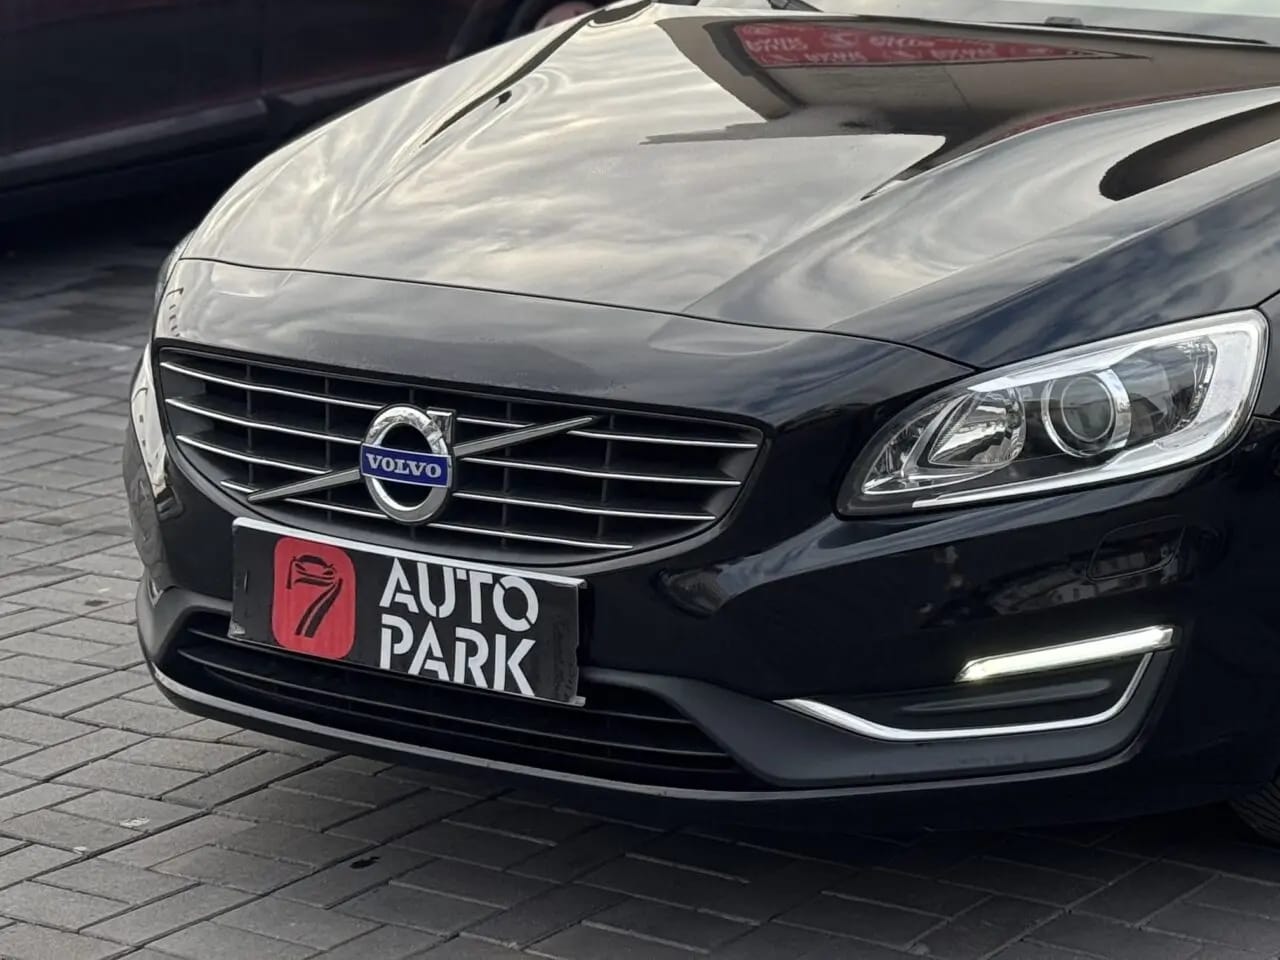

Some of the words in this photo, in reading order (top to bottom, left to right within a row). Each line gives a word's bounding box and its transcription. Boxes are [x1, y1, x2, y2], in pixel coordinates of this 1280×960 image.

[365, 452, 442, 478] VOLVO
[379, 557, 540, 633] AUTO
[378, 613, 537, 697] PARK
